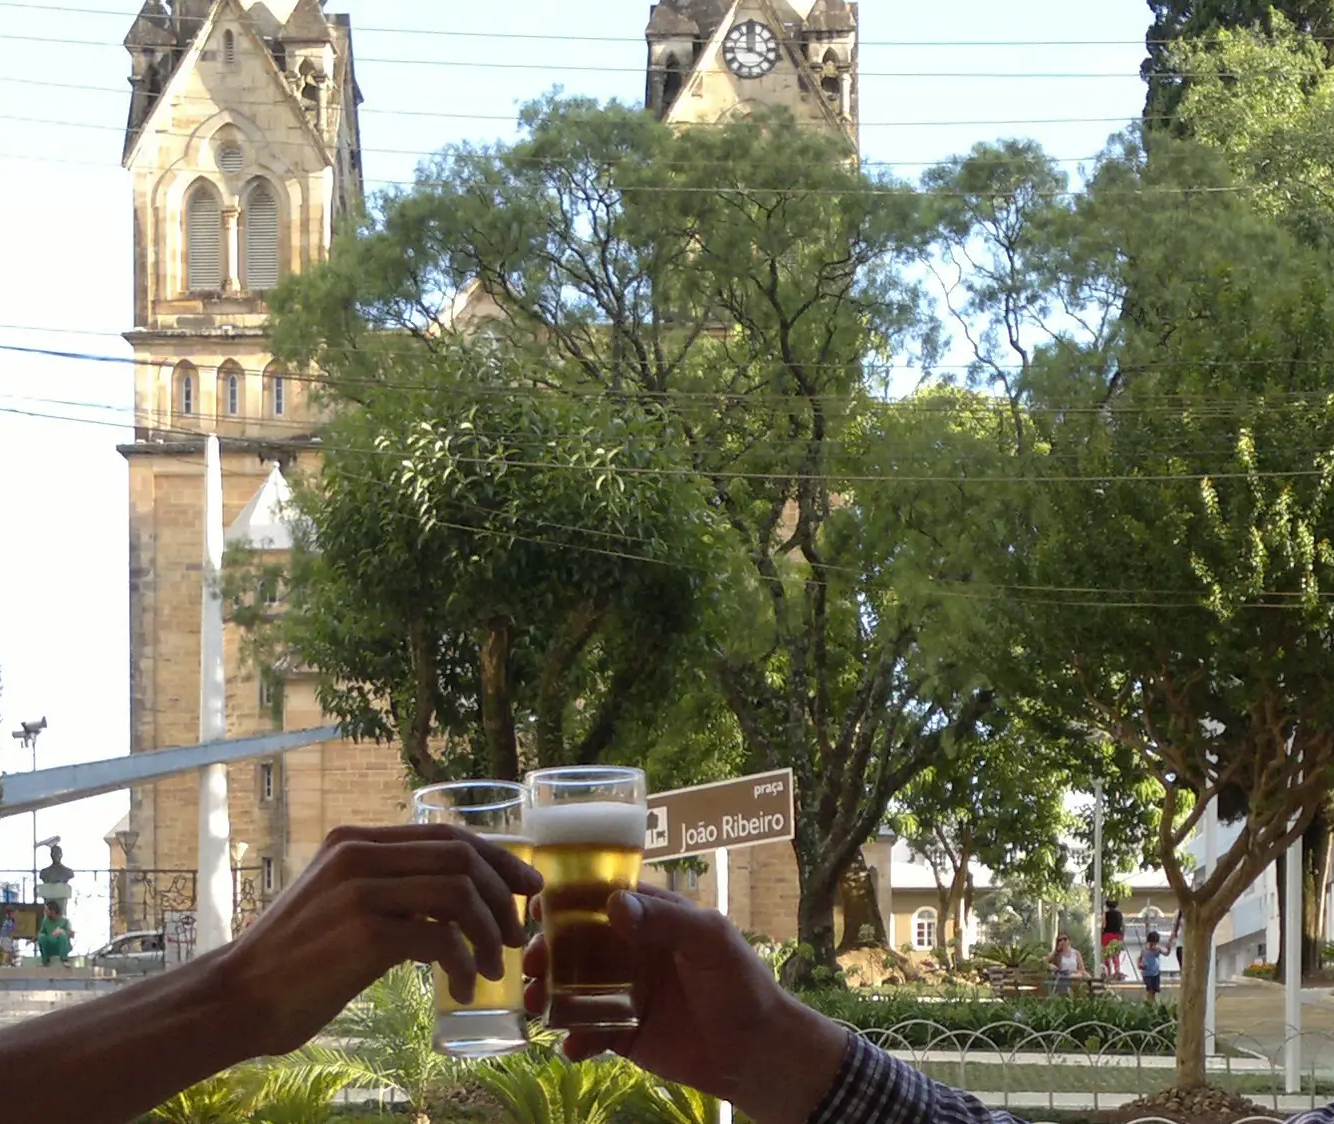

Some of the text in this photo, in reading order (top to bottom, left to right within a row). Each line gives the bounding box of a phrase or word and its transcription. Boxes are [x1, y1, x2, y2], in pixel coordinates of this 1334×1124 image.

[753, 781, 783, 800] praça
[680, 811, 784, 853] João Ribeiro
